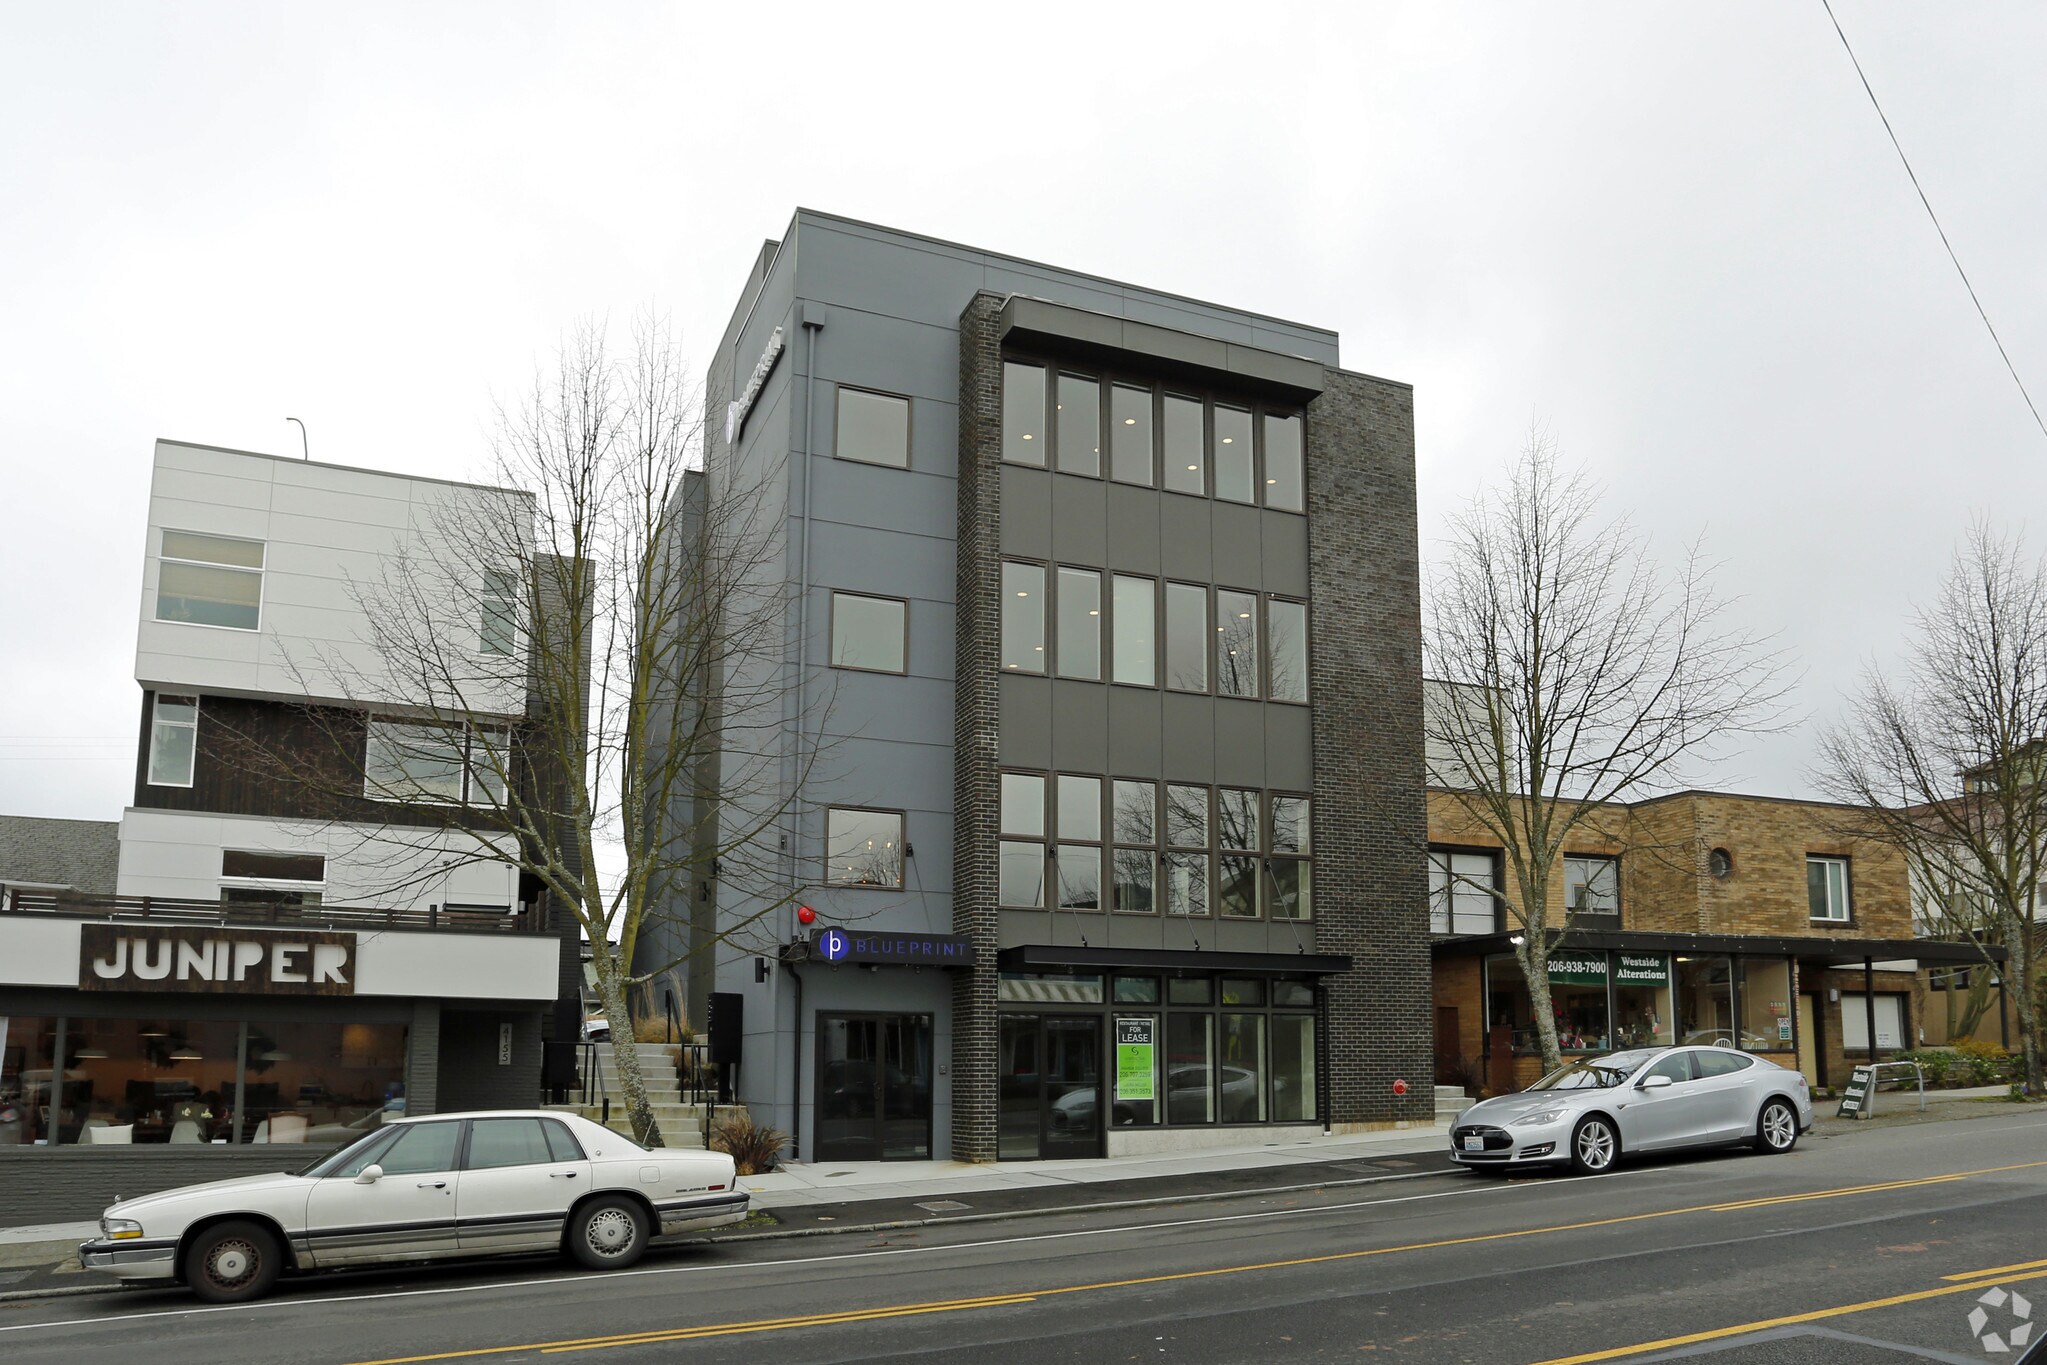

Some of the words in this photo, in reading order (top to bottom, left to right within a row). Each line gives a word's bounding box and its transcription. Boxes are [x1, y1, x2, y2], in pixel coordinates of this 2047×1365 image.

[856, 939, 967, 957] BLUEPRINT
[93, 937, 349, 984] JUNIPER
[1621, 957, 1660, 967] Westside
[1547, 961, 1606, 974] 206-938-7900
[1617, 968, 1666, 980] Alterations
[1122, 1033, 1149, 1042] LEASE
